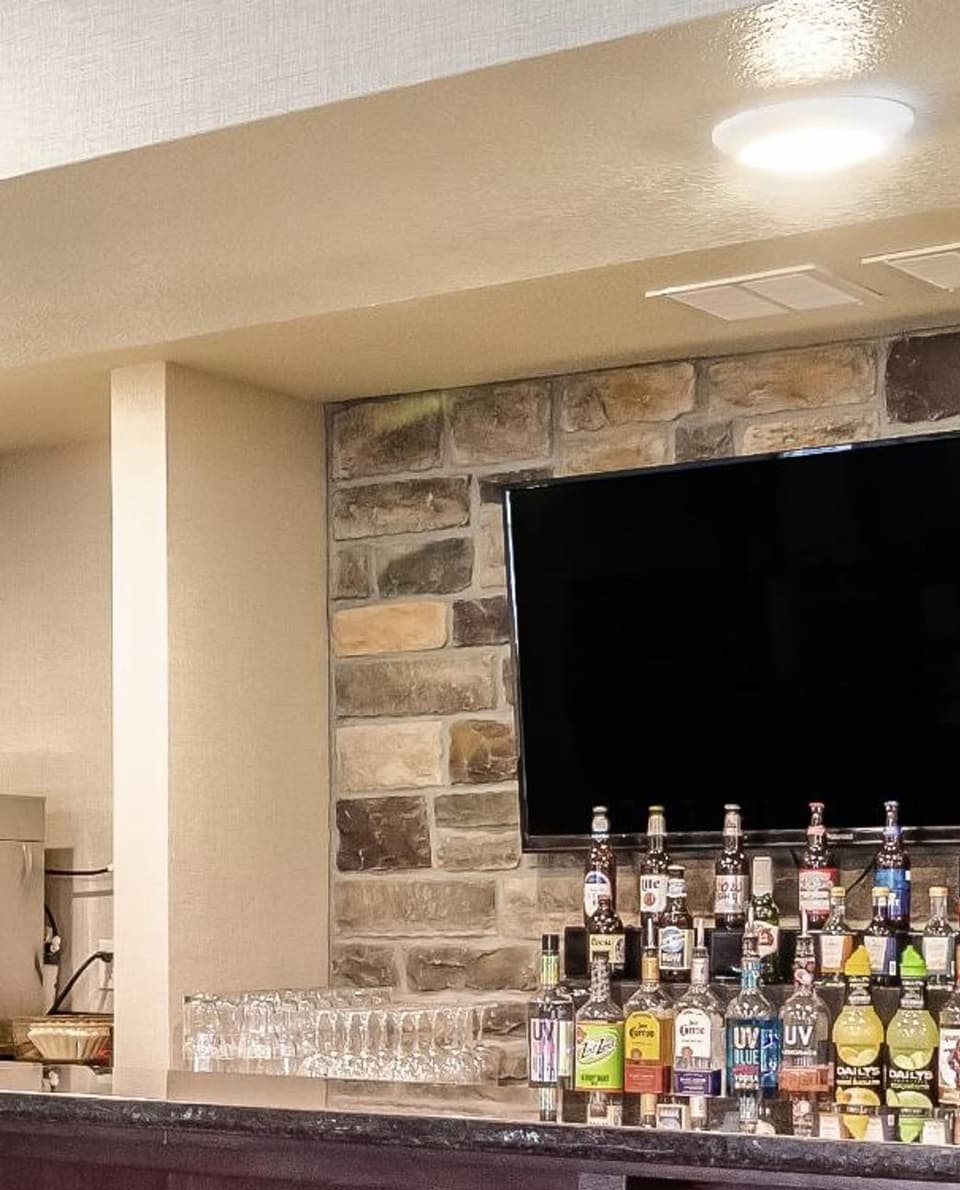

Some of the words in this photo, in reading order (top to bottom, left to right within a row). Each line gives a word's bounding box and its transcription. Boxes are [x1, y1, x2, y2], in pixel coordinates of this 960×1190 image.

[733, 1027, 759, 1049] UV
[785, 1026, 813, 1045] UV
[734, 1050, 759, 1065] BLUE
